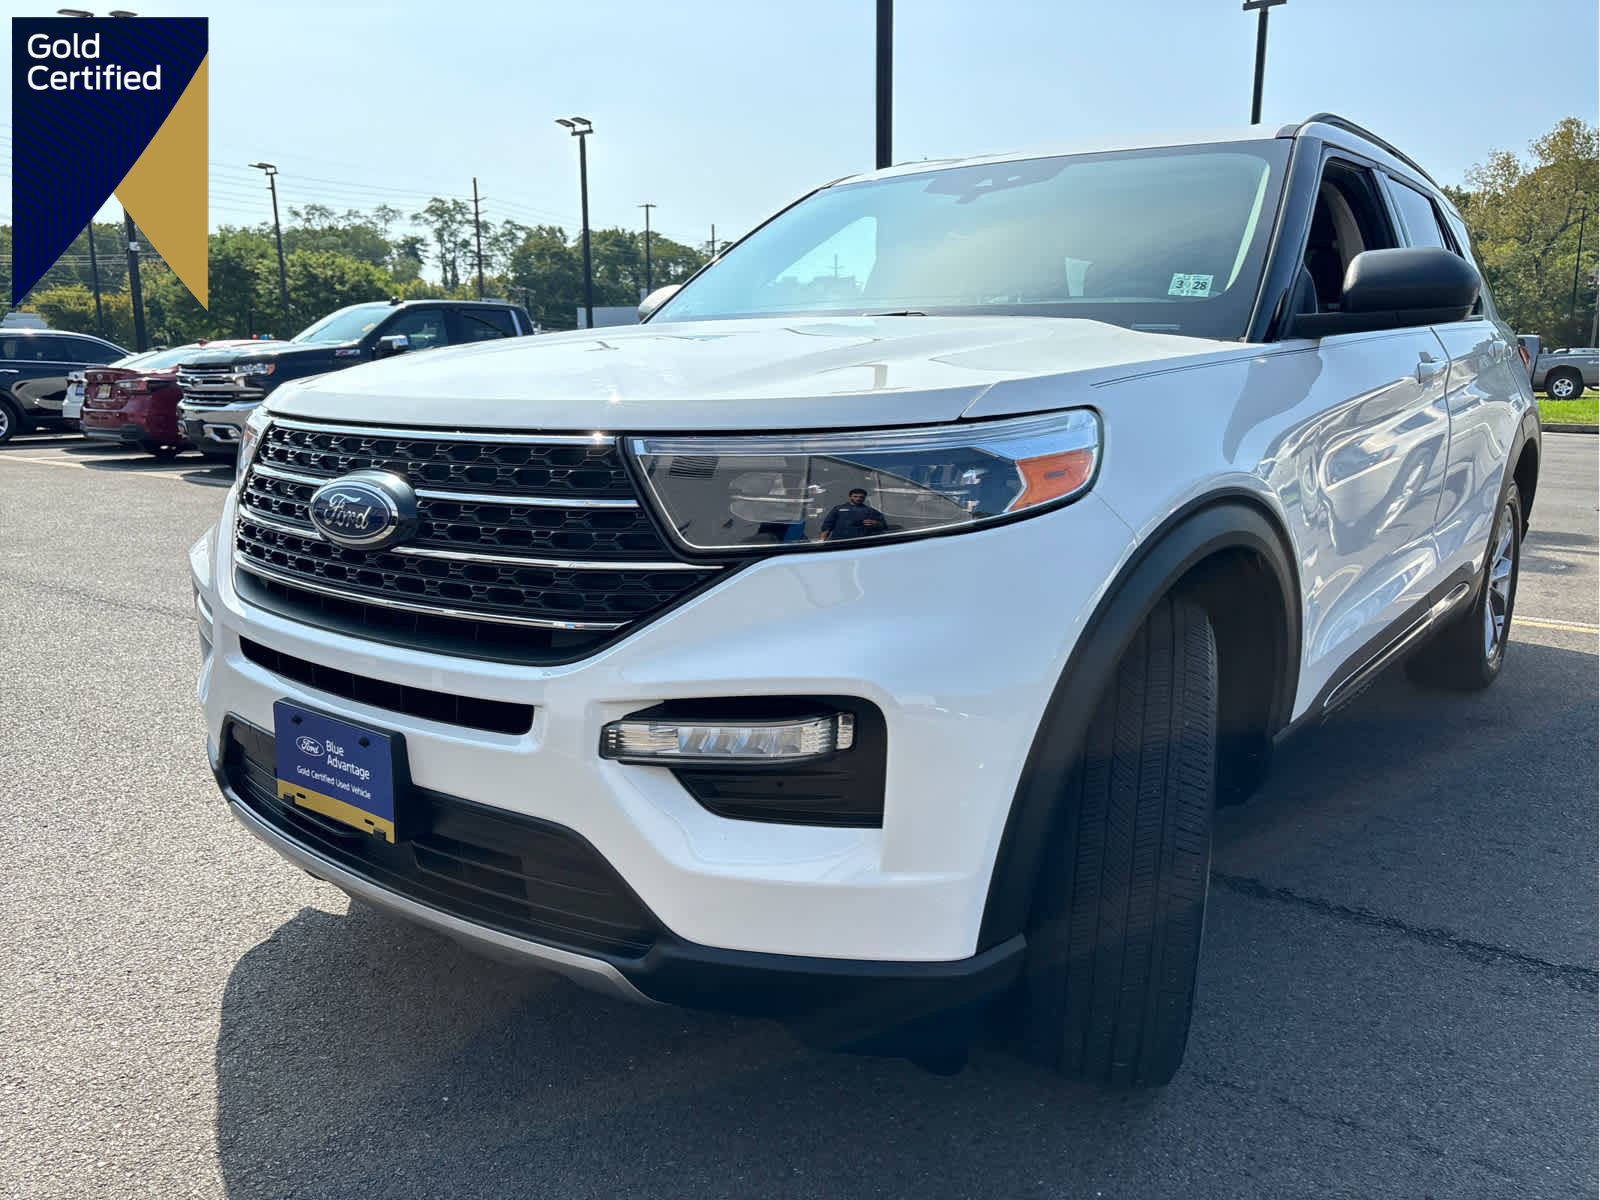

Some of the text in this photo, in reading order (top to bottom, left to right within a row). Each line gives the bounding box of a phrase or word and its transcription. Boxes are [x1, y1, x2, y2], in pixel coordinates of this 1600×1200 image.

[1175, 280, 1208, 290] 3 28
[323, 493, 372, 529] Ford
[301, 738, 320, 754] Ford
[326, 740, 344, 756] Blue
[327, 754, 370, 780] Advantage
[297, 765, 371, 799] Gold Certified Used Vehicle
